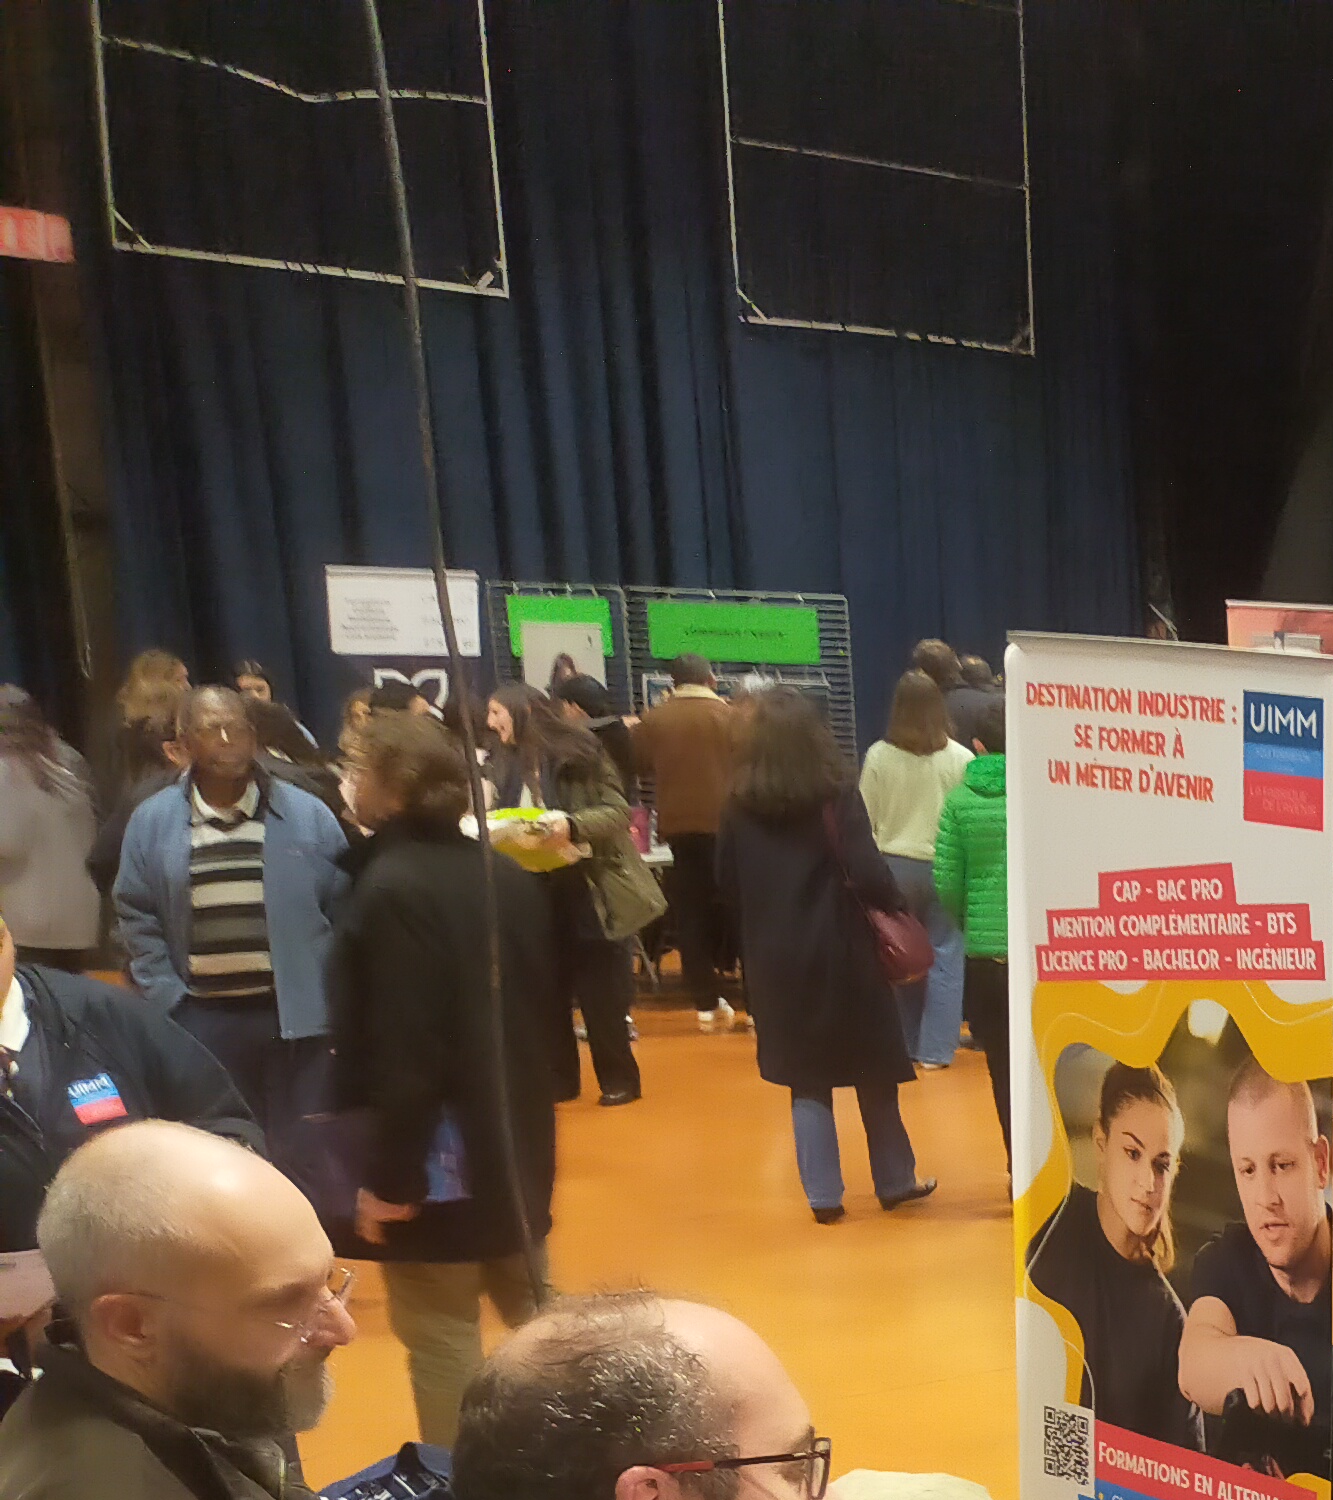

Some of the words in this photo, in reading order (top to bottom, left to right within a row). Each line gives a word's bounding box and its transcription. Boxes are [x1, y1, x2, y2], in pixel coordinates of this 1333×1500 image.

[1026, 682, 1132, 713] DESTINATION
[1138, 691, 1225, 724] INDUSTRIE
[1250, 702, 1317, 739] UIMM
[1074, 724, 1093, 750] SE
[1099, 726, 1166, 757] FORMER
[1172, 728, 1185, 760] À
[1048, 758, 1071, 785] UN
[1076, 755, 1132, 793] MÉTIER
[1139, 764, 1215, 804] D'AVENIR
[1113, 880, 1141, 902] CAP
[1157, 878, 1187, 902] BAC
[1191, 877, 1223, 901] PRO
[1053, 915, 1115, 938] MENTION
[1119, 909, 1251, 937] COMPLÉMENTAIRE
[1267, 912, 1297, 935] BTS
[1041, 949, 1094, 972] LICENCE
[1098, 948, 1127, 971] PRO
[1143, 948, 1220, 971] BACHELOR
[1237, 943, 1317, 971] INGÉNIEUR
[1098, 1441, 1189, 1489] FORMATIONS
[1194, 1472, 1213, 1497] EN
